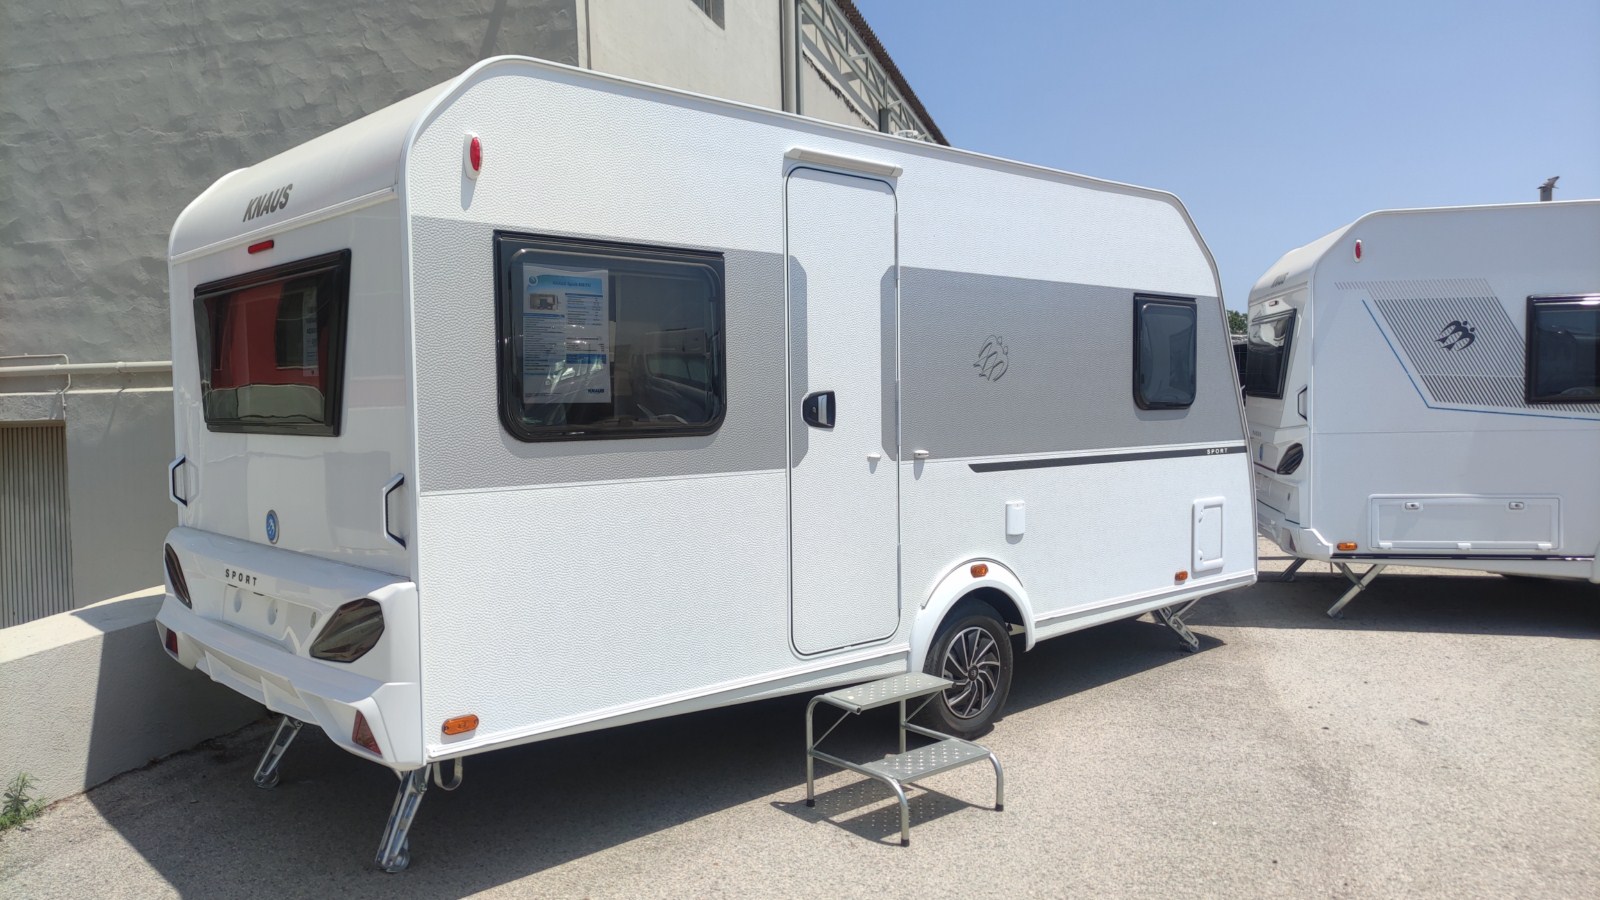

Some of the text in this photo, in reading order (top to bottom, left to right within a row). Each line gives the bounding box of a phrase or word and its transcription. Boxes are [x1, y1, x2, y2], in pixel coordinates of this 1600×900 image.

[242, 183, 293, 222] KNAUS
[1206, 447, 1228, 455] SPORT
[225, 568, 257, 586] SPORT
